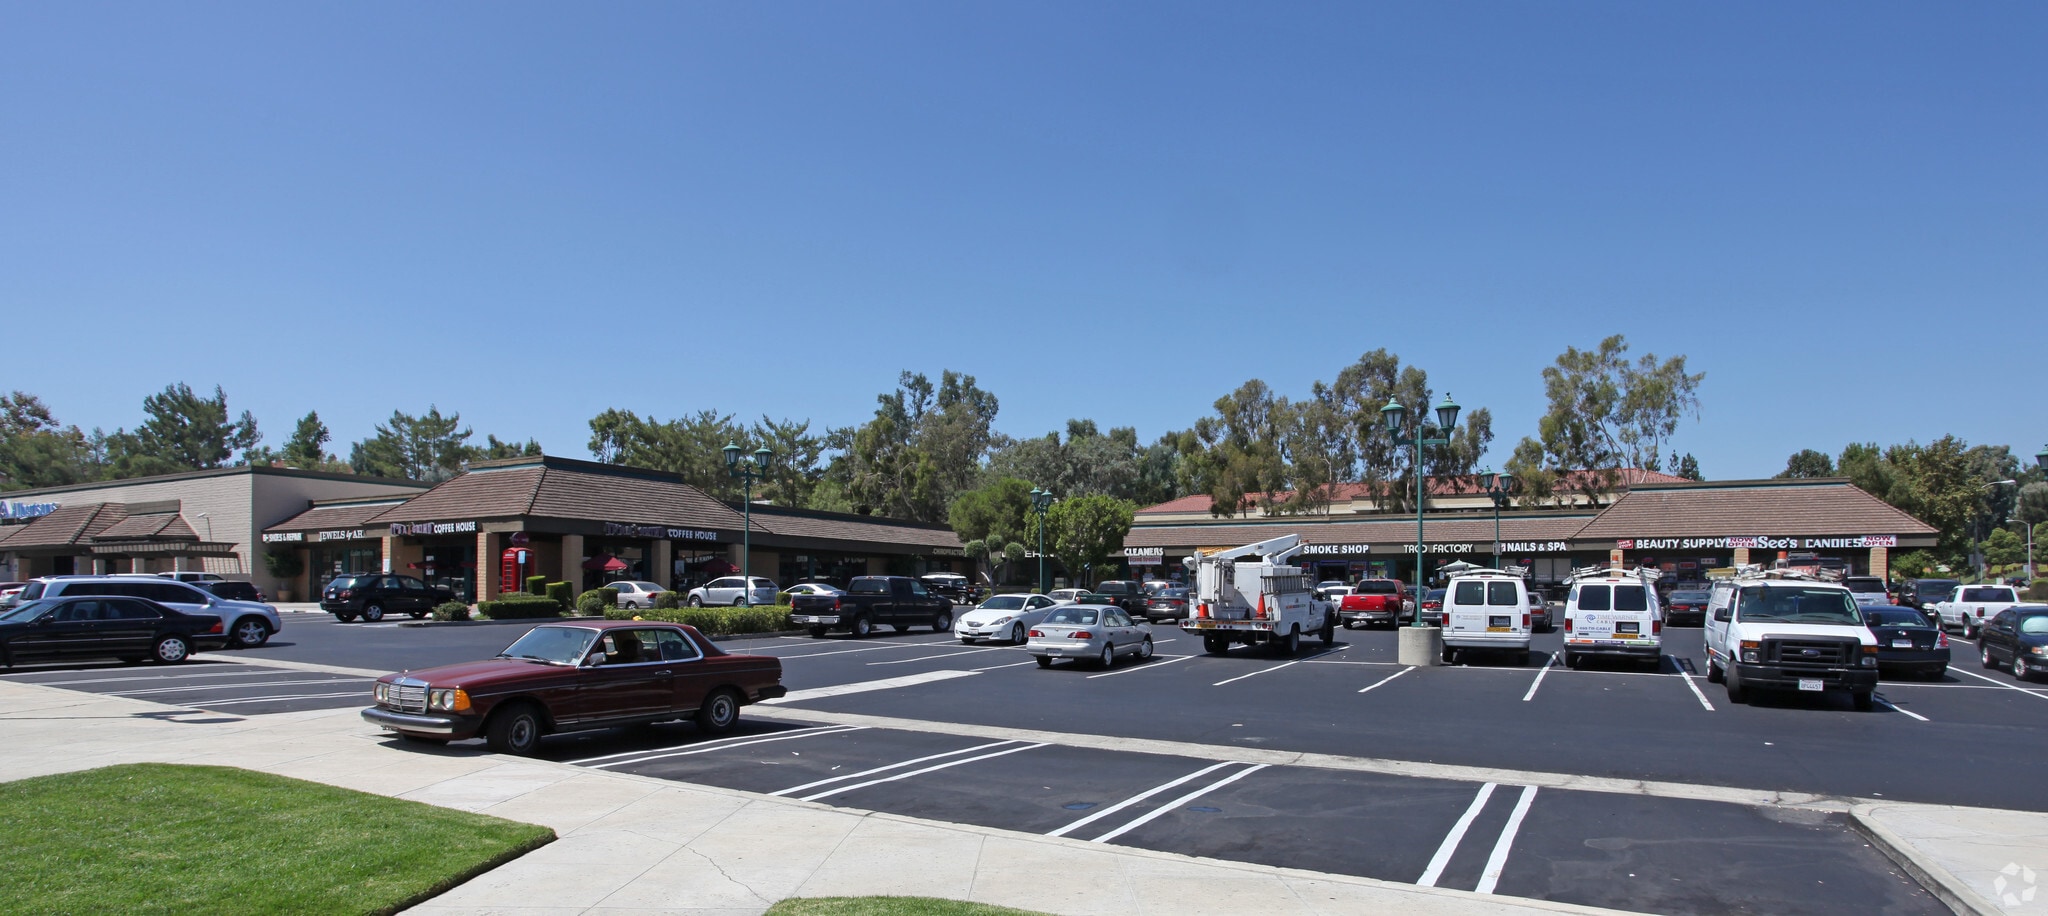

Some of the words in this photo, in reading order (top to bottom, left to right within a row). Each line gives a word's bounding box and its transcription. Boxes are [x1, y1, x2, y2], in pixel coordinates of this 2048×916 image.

[434, 522, 455, 534] COFFEE
[455, 521, 476, 532] HOUSE
[269, 533, 282, 542] SHOES
[287, 532, 303, 541] REPAIR
[319, 530, 346, 542] JEWELS
[667, 529, 693, 539] COFFEE
[695, 531, 717, 541] HOUSE
[1507, 542, 1537, 552] NAILS
[1538, 542, 1545, 552] &
[1547, 542, 1567, 551] SPA
[1636, 539, 1679, 549] BEAUTY
[1683, 538, 1726, 549] SUPPLY
[1757, 536, 1798, 549] See's
[1805, 538, 1861, 548] CANDIES
[1124, 547, 1164, 556] CLEANERS
[1303, 545, 1339, 554] SMOKE
[1341, 545, 1369, 554] SHOP
[1432, 544, 1473, 553] FACTORY
